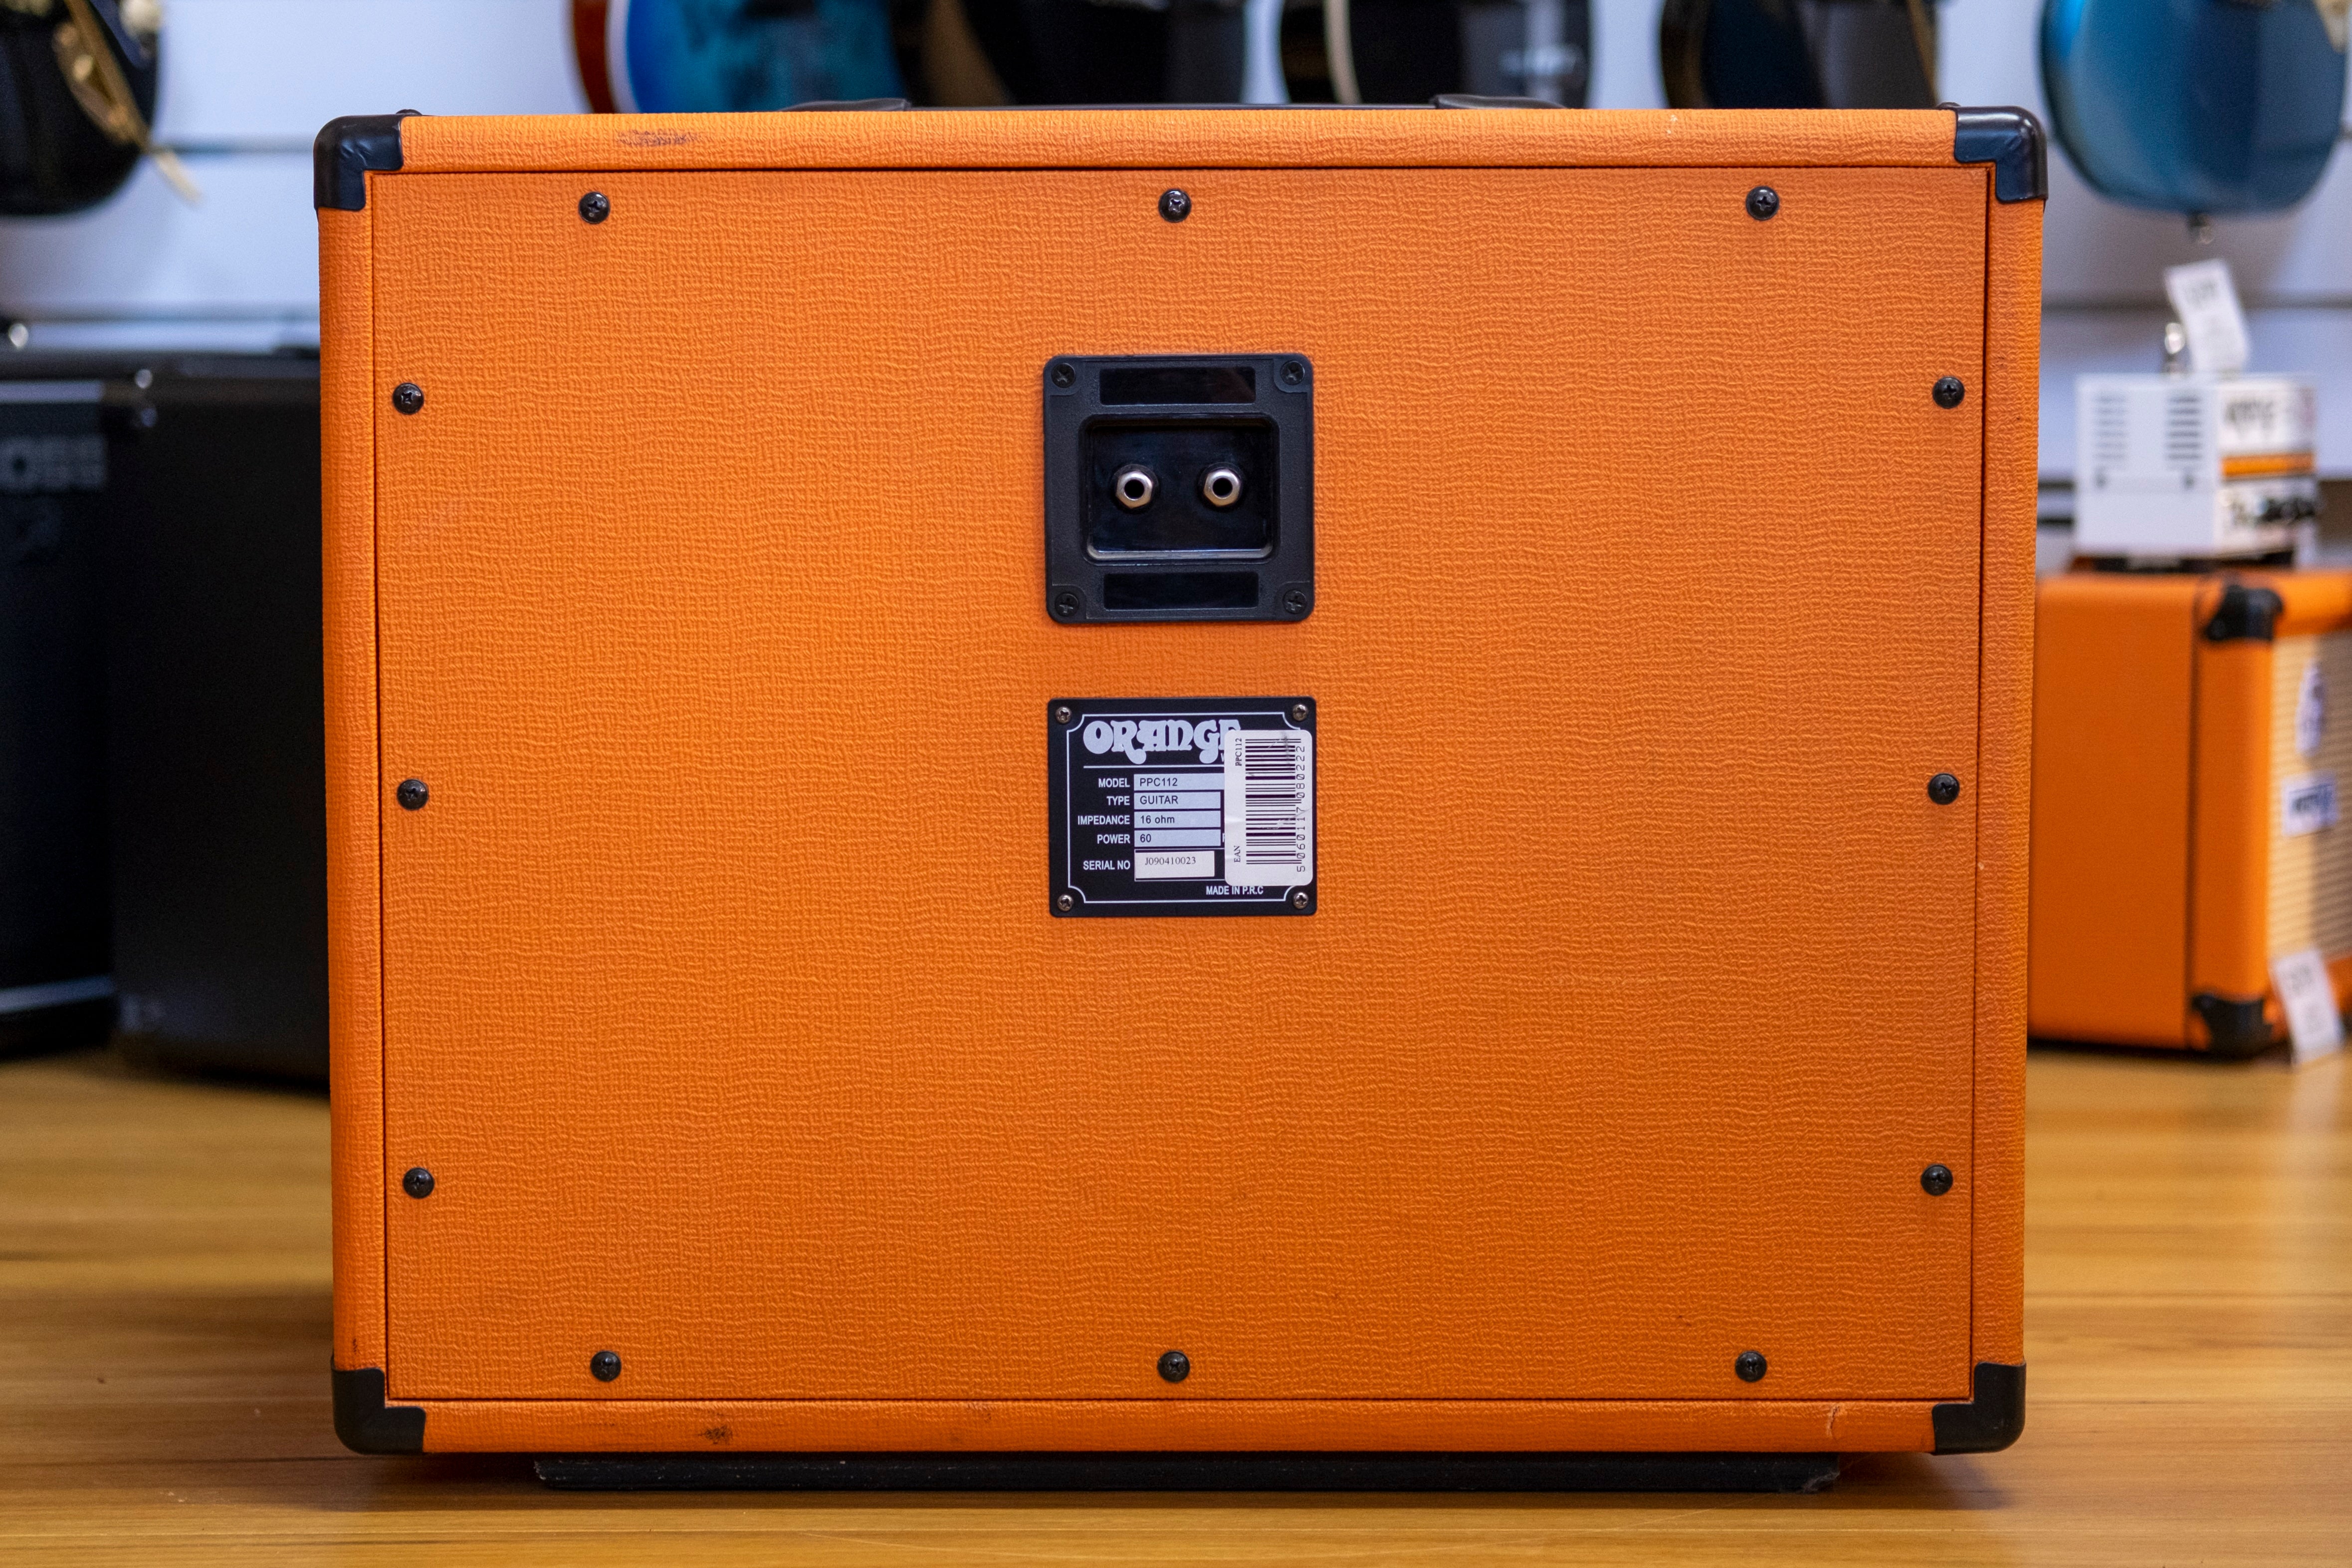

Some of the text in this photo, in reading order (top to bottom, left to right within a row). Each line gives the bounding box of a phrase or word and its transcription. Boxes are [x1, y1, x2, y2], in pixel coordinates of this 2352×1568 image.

[1098, 777, 1178, 788] MODEL PPC112
[1106, 795, 1179, 806] TYPE GUITAR
[1077, 815, 1130, 825] IMPEDANCE
[1155, 815, 1175, 824] ohm
[1097, 834, 1152, 844] POWER 60
[1083, 856, 1197, 871] SERIAL NO J090410023
[1206, 885, 1264, 895] MADE IN P.R.C
